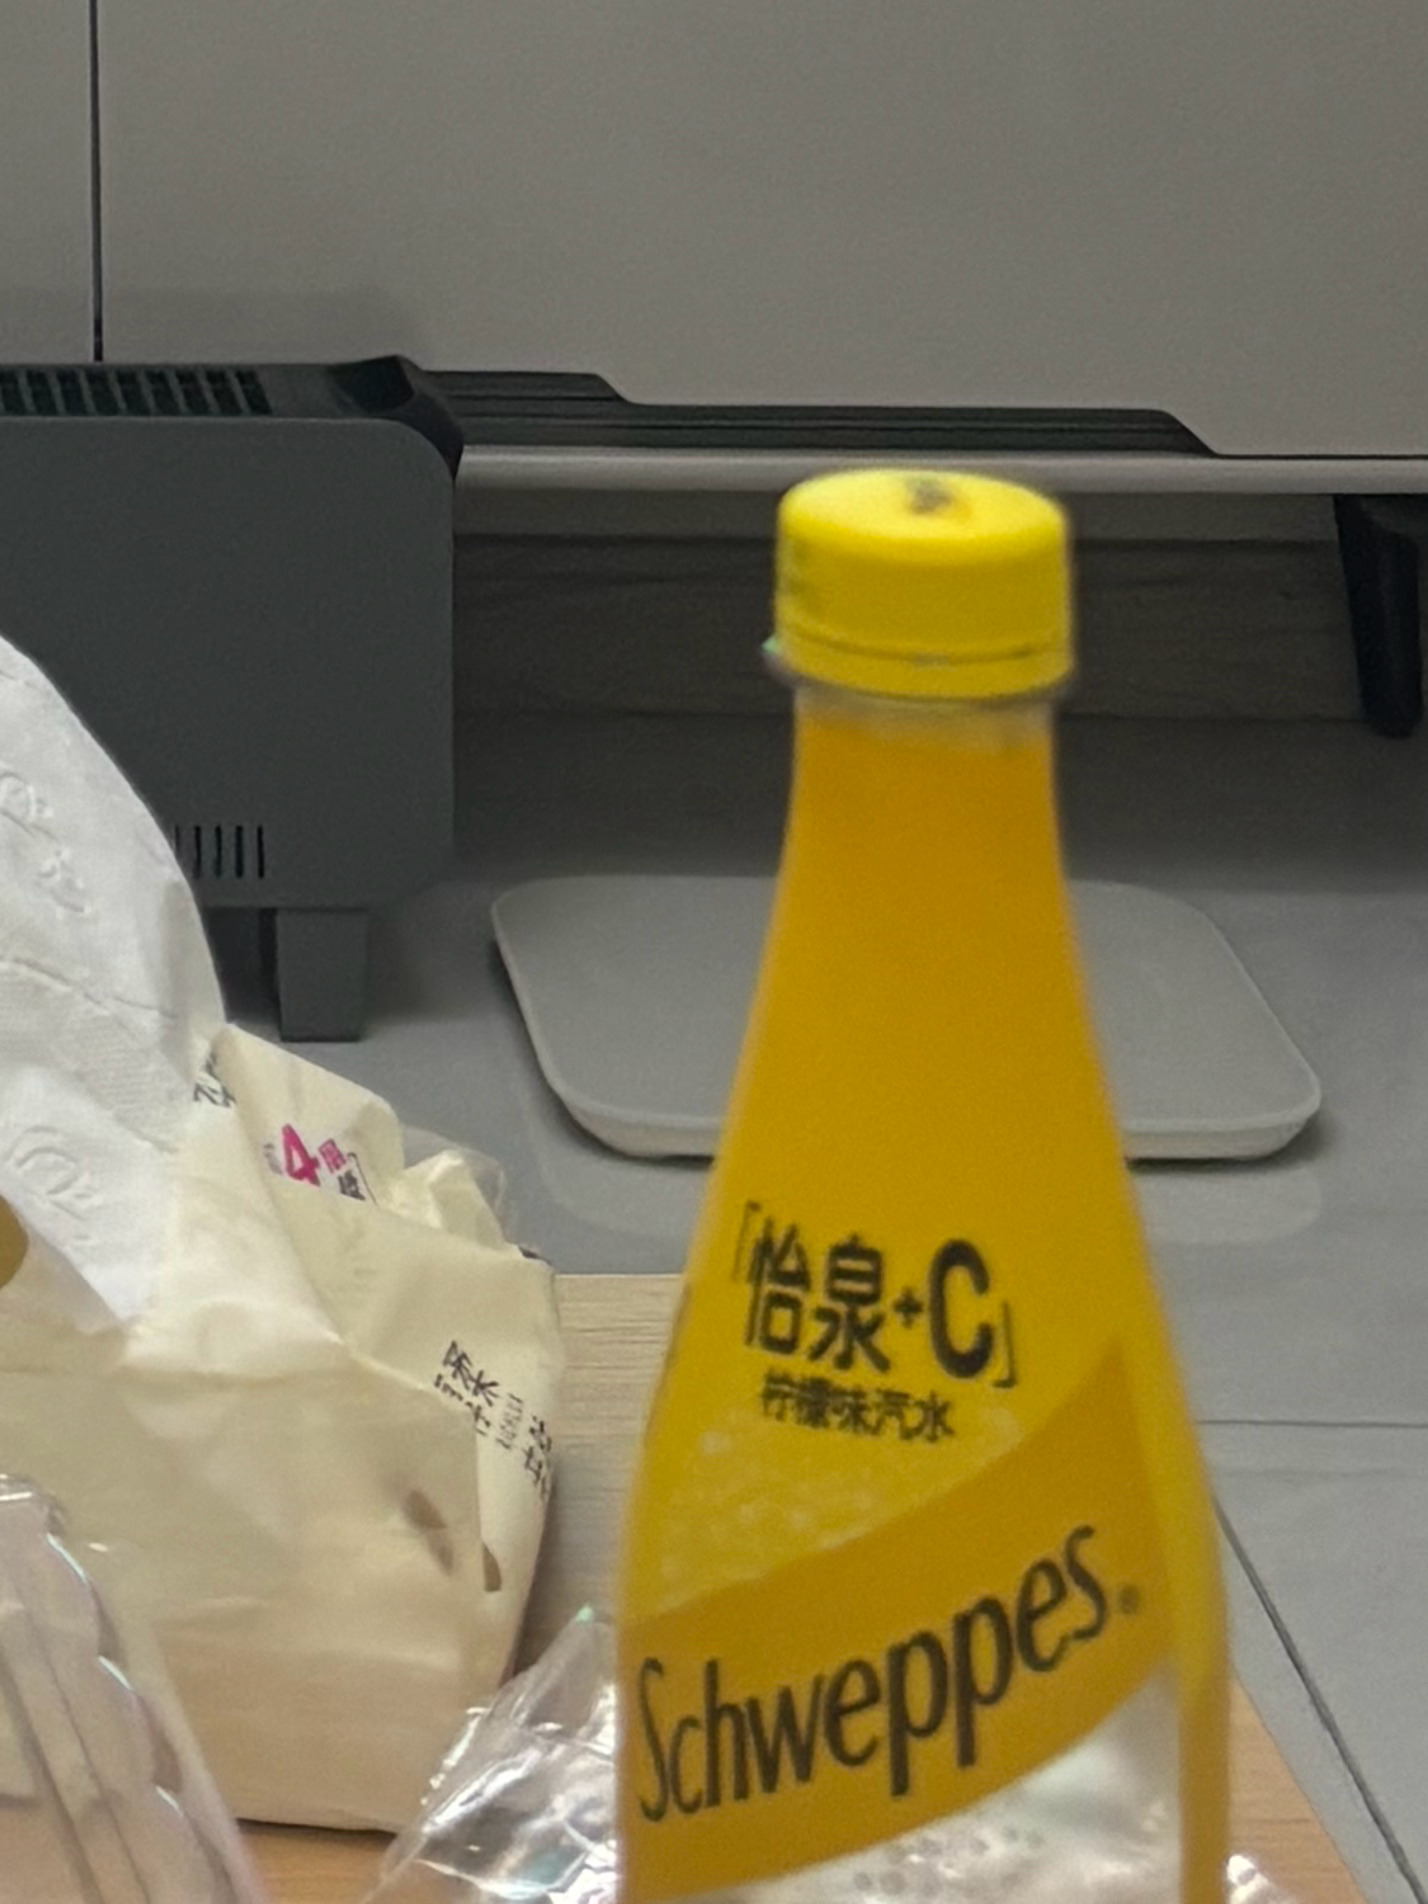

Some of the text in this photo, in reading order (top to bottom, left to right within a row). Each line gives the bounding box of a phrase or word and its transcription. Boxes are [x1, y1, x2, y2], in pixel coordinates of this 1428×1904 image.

[758, 1367, 957, 1442] 柠檬味汽水
[638, 1524, 1112, 1824] Schweppes
